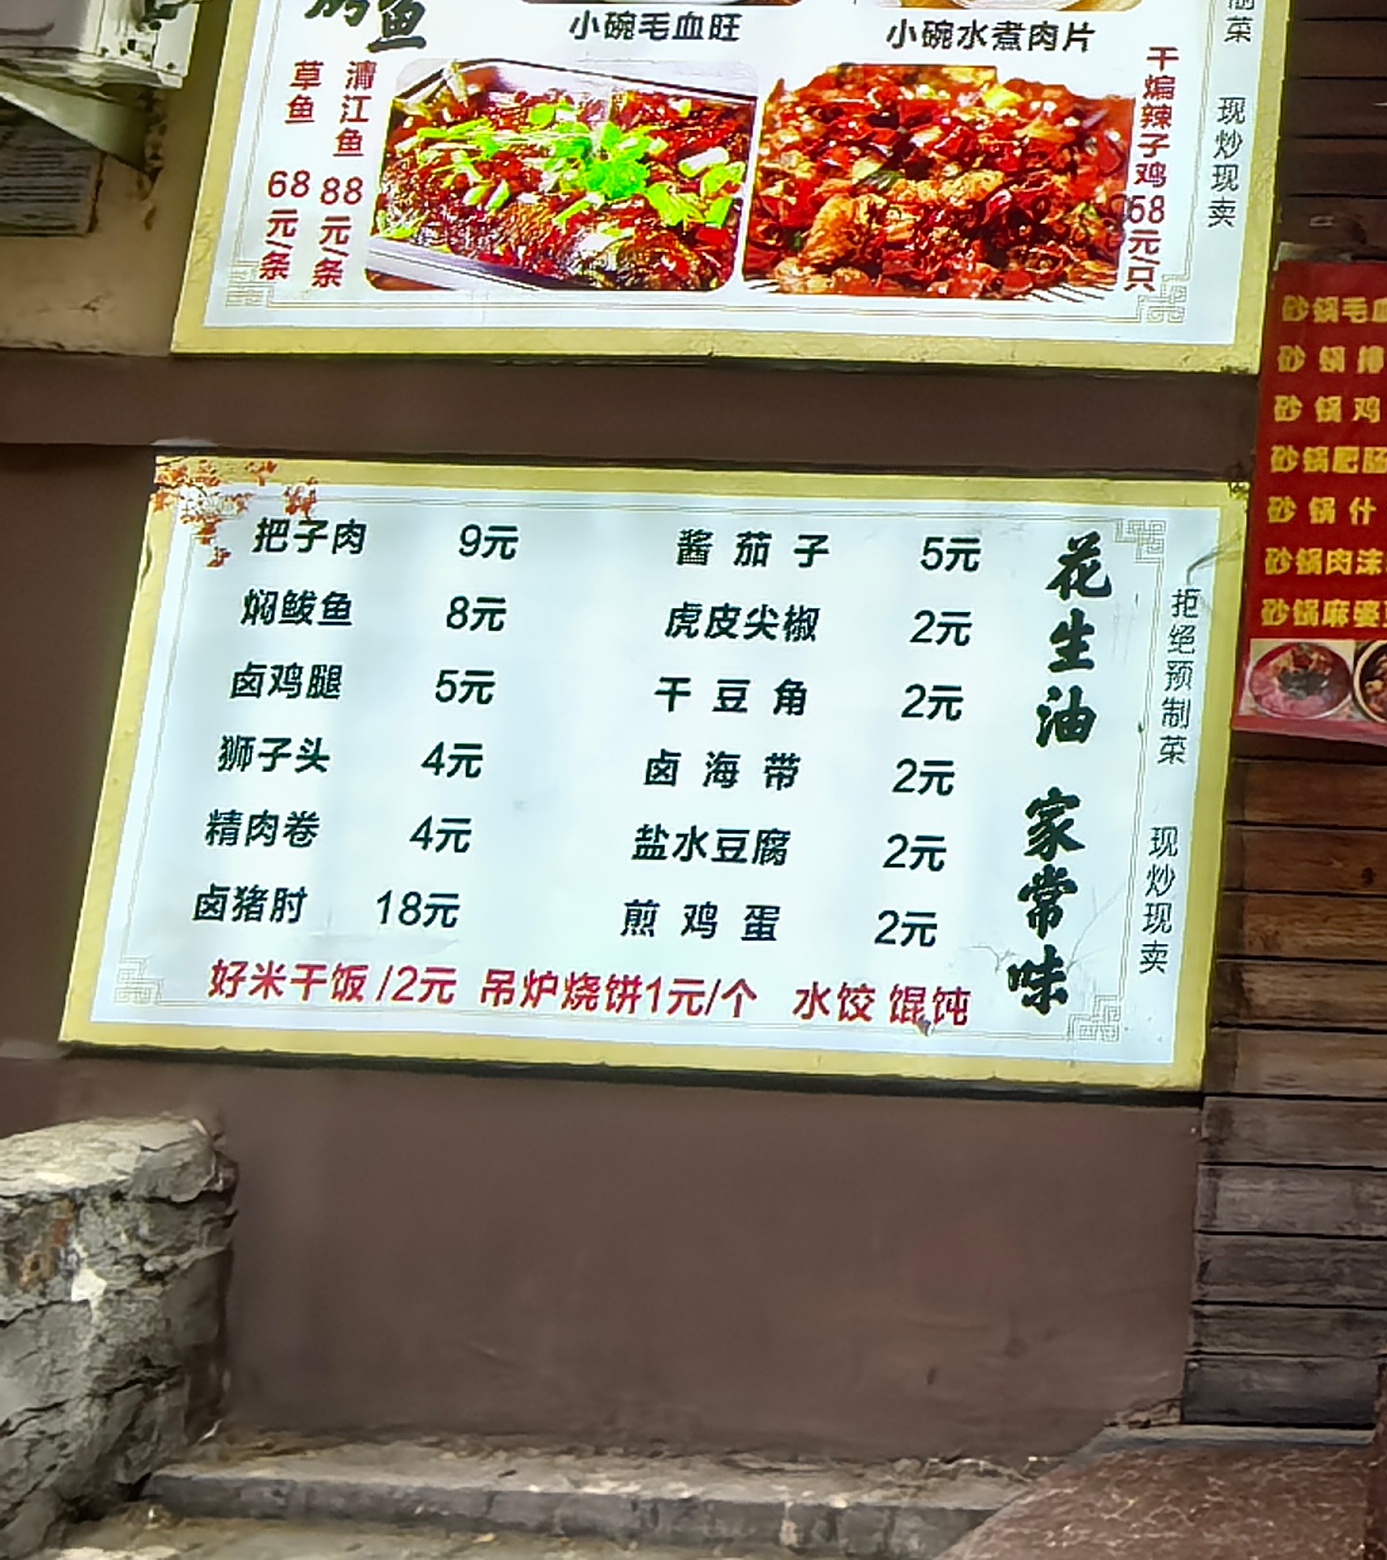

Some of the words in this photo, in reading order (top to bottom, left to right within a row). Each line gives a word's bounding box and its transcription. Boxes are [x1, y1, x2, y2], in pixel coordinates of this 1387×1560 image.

[569, 9, 743, 43] 小碗毛血旺
[886, 18, 1096, 54] 小碗水煮肉片
[284, 59, 324, 124] 草鱼
[332, 59, 378, 158] 清江鱼
[1207, 96, 1247, 229] 现炒现卖
[250, 517, 367, 555] 把子肉
[458, 524, 520, 560] 9元
[676, 528, 830, 569] 酱茄子
[920, 536, 982, 572] 5元
[240, 587, 353, 627] 焖鲅鱼
[446, 595, 507, 632] 8元
[664, 601, 821, 643] 虎皮尖椒
[909, 609, 974, 648] 2元
[1035, 530, 1112, 749] 花生油
[229, 660, 344, 701] 卤鸡腿
[434, 668, 497, 705] 5元
[653, 676, 809, 717] 干豆角
[900, 683, 965, 722] 2元
[1157, 587, 1203, 767] 拒绝预制菜
[217, 734, 331, 775] 狮子头
[420, 741, 484, 779] 4元
[643, 748, 801, 791] 卤海带
[892, 758, 956, 796] 2元
[205, 808, 321, 849] 精肉卷
[409, 815, 473, 854] 4元
[631, 823, 791, 867] 盐水豆腐
[882, 833, 947, 872] 2元
[192, 882, 308, 925] 卤猪肘
[376, 890, 461, 928] 18元
[620, 898, 781, 943] 煎鸡蛋
[873, 910, 938, 948] 2元
[1006, 786, 1086, 1016] 家常味
[1139, 825, 1180, 975] 现炒现卖
[479, 967, 758, 1018] 吊炉烧饼1元/个
[792, 981, 877, 1024] 水饺
[888, 984, 973, 1028] 馄饨
